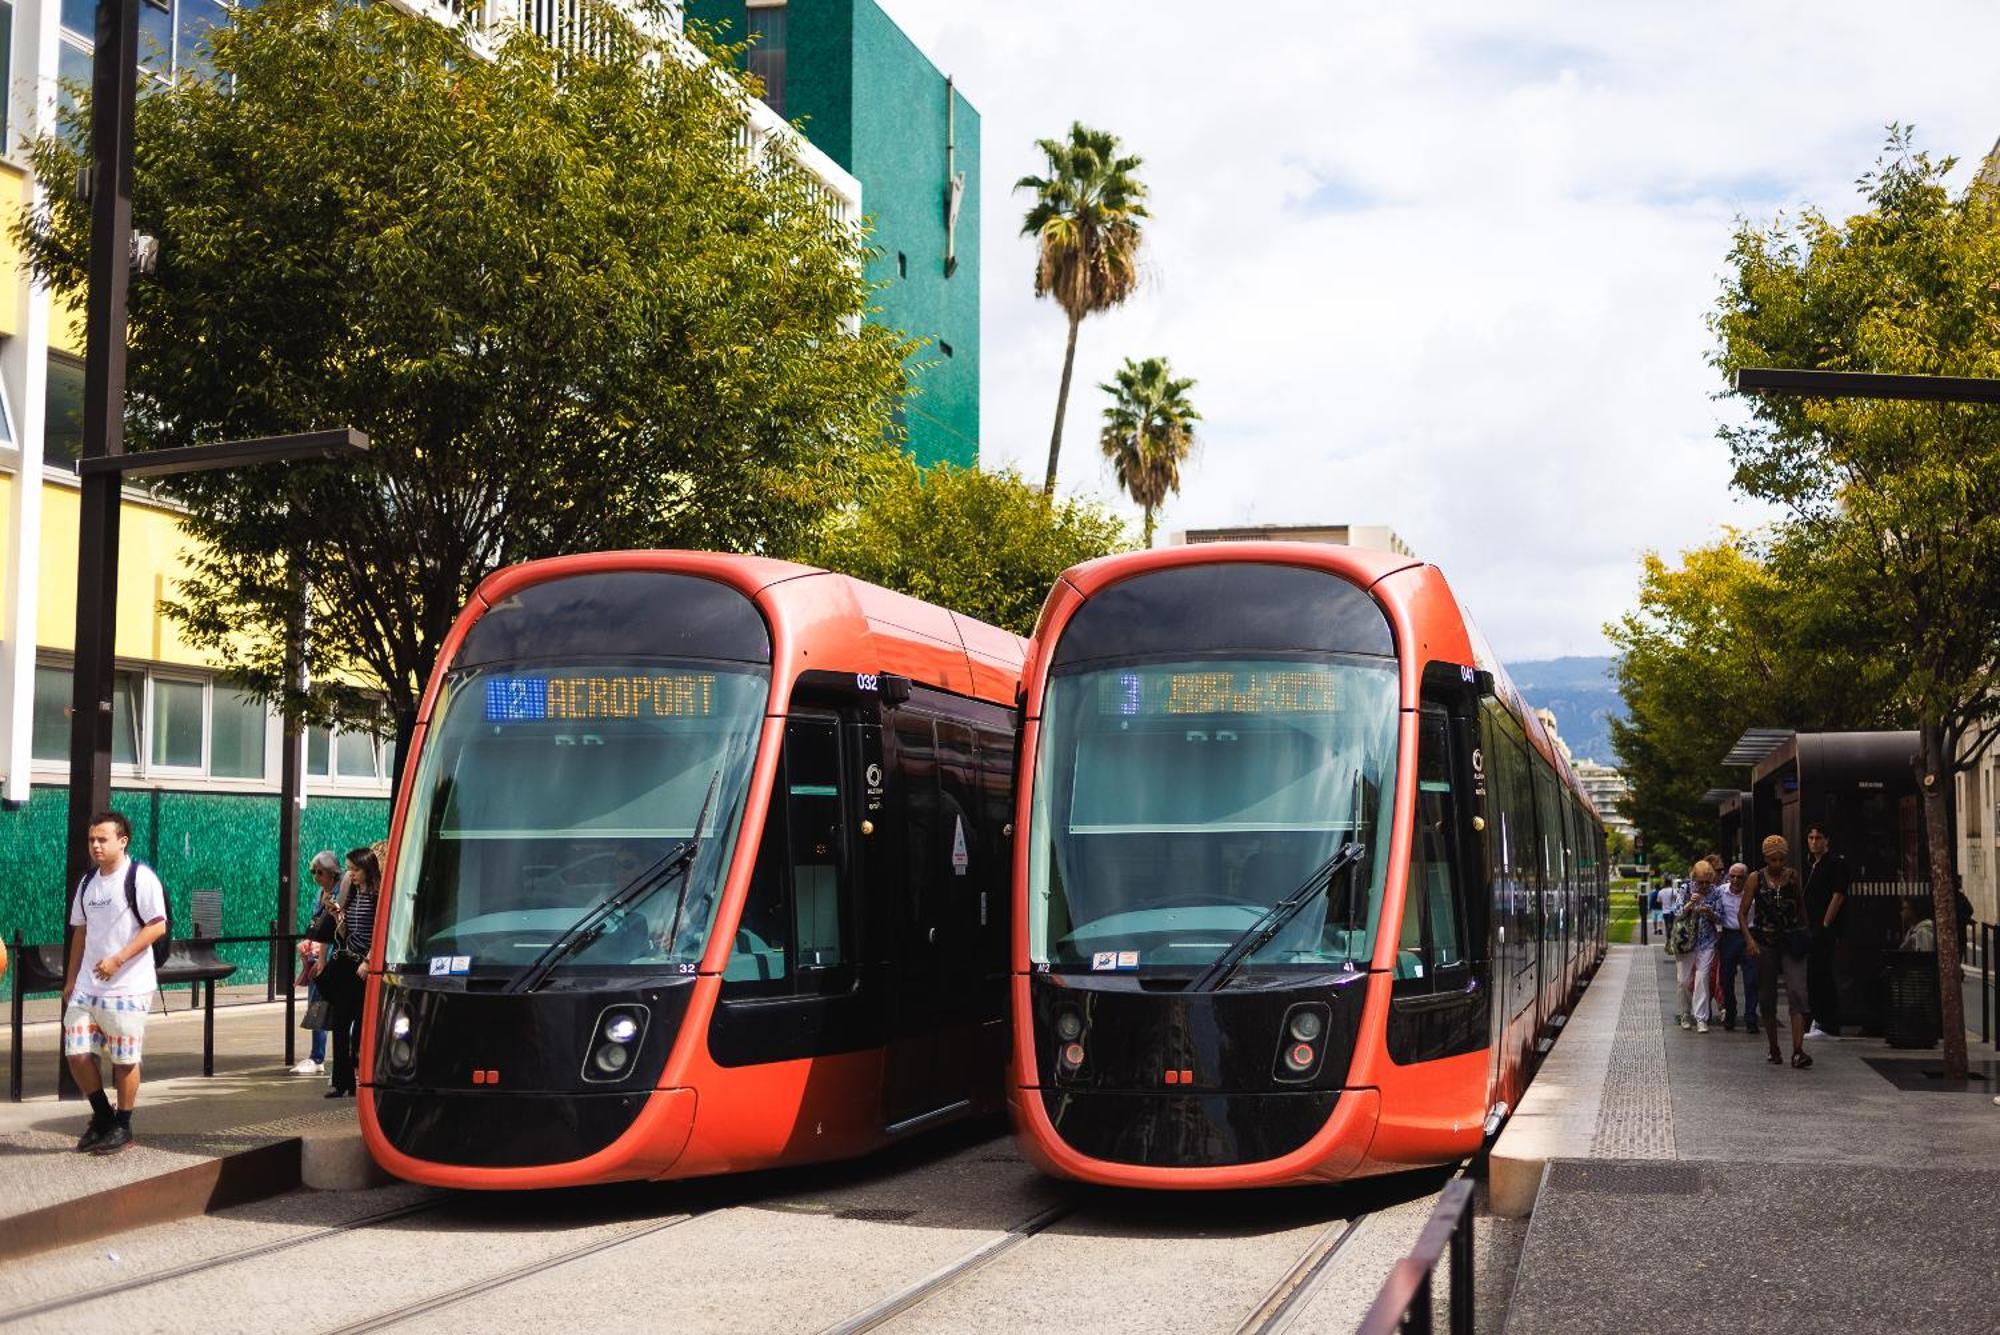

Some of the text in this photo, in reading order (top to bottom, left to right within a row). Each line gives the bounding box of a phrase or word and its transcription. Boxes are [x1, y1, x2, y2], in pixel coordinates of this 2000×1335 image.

[857, 673, 878, 691] 032
[547, 675, 715, 718] AEROPORT
[679, 963, 696, 973] 32
